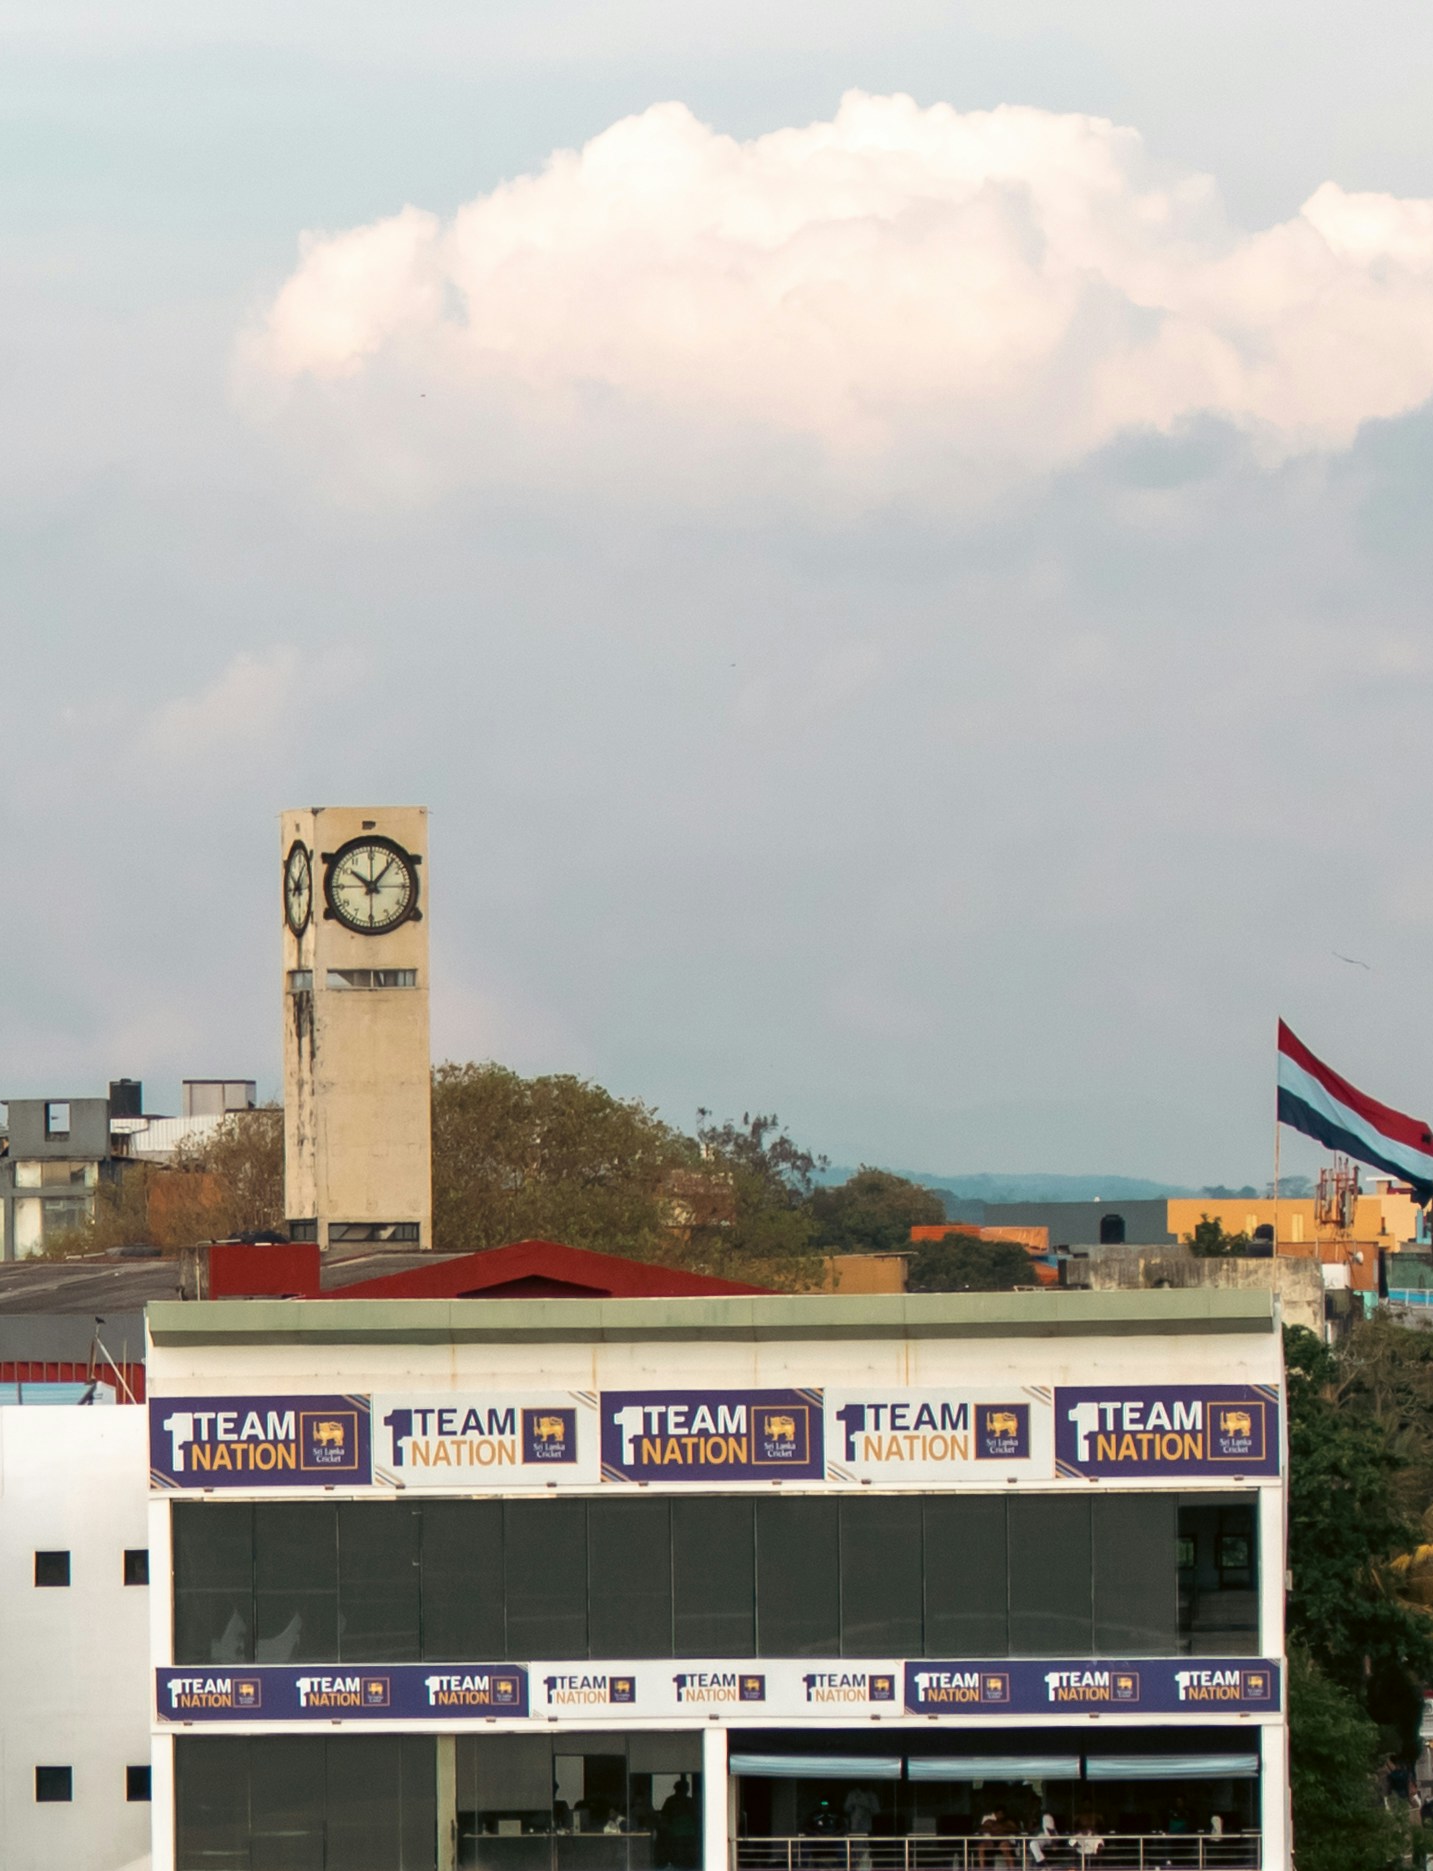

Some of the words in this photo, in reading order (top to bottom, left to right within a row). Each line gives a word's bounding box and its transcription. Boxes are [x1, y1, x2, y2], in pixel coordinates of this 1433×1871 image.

[414, 1408, 515, 1436] TEAM
[644, 1405, 746, 1435] TEAM
[867, 1403, 968, 1431] TEAM
[1099, 1401, 1202, 1431] TEAM
[194, 1411, 295, 1441] TEAM
[764, 1442, 774, 1450] Sri
[776, 1442, 795, 1450] Lanka
[864, 1435, 968, 1461] NATION
[986, 1438, 997, 1446] Sri
[999, 1438, 1018, 1446] Lanka
[1097, 1433, 1202, 1461] NATION
[192, 1443, 296, 1471] NATION
[412, 1439, 516, 1466] NATION
[537, 1450, 562, 1458] Cricket
[642, 1436, 747, 1464] NATION
[990, 1446, 1015, 1454] Cricket
[316, 1455, 341, 1463] Cricket
[310, 1692, 360, 1707] NATION
[438, 1691, 489, 1705] NATION
[557, 1690, 607, 1704] NATION
[686, 1688, 736, 1702] NATION
[816, 1688, 866, 1702] NATION
[928, 1687, 979, 1701] NATION
[1058, 1686, 1109, 1701] NATION
[1188, 1686, 1240, 1700] NATION
[181, 1694, 232, 1708] NATION
